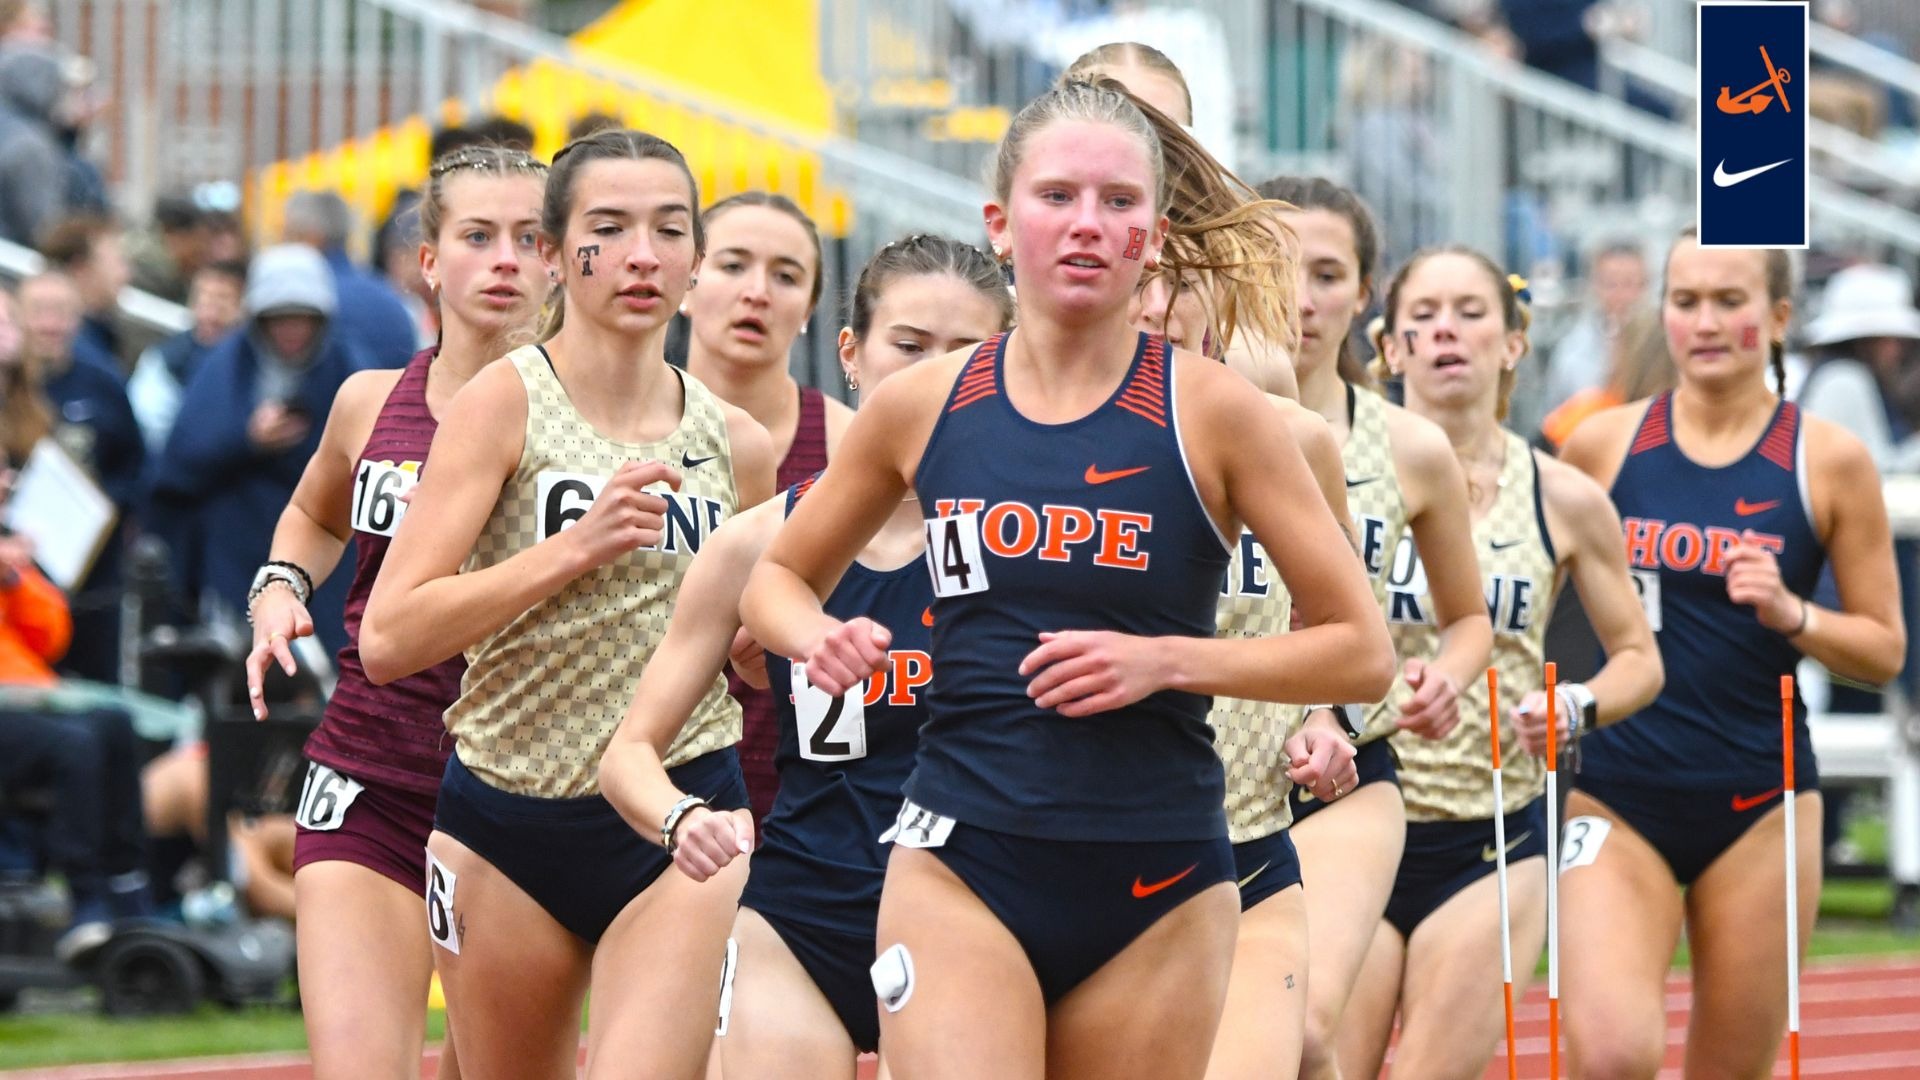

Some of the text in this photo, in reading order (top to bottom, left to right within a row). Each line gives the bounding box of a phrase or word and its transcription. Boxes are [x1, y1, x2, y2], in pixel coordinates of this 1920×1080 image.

[577, 244, 600, 277] T
[1122, 225, 1147, 261] H
[356, 465, 402, 532] 16
[544, 478, 595, 542] 6
[807, 670, 851, 756] 2
[299, 763, 348, 828] 16
[427, 863, 450, 942] 6
